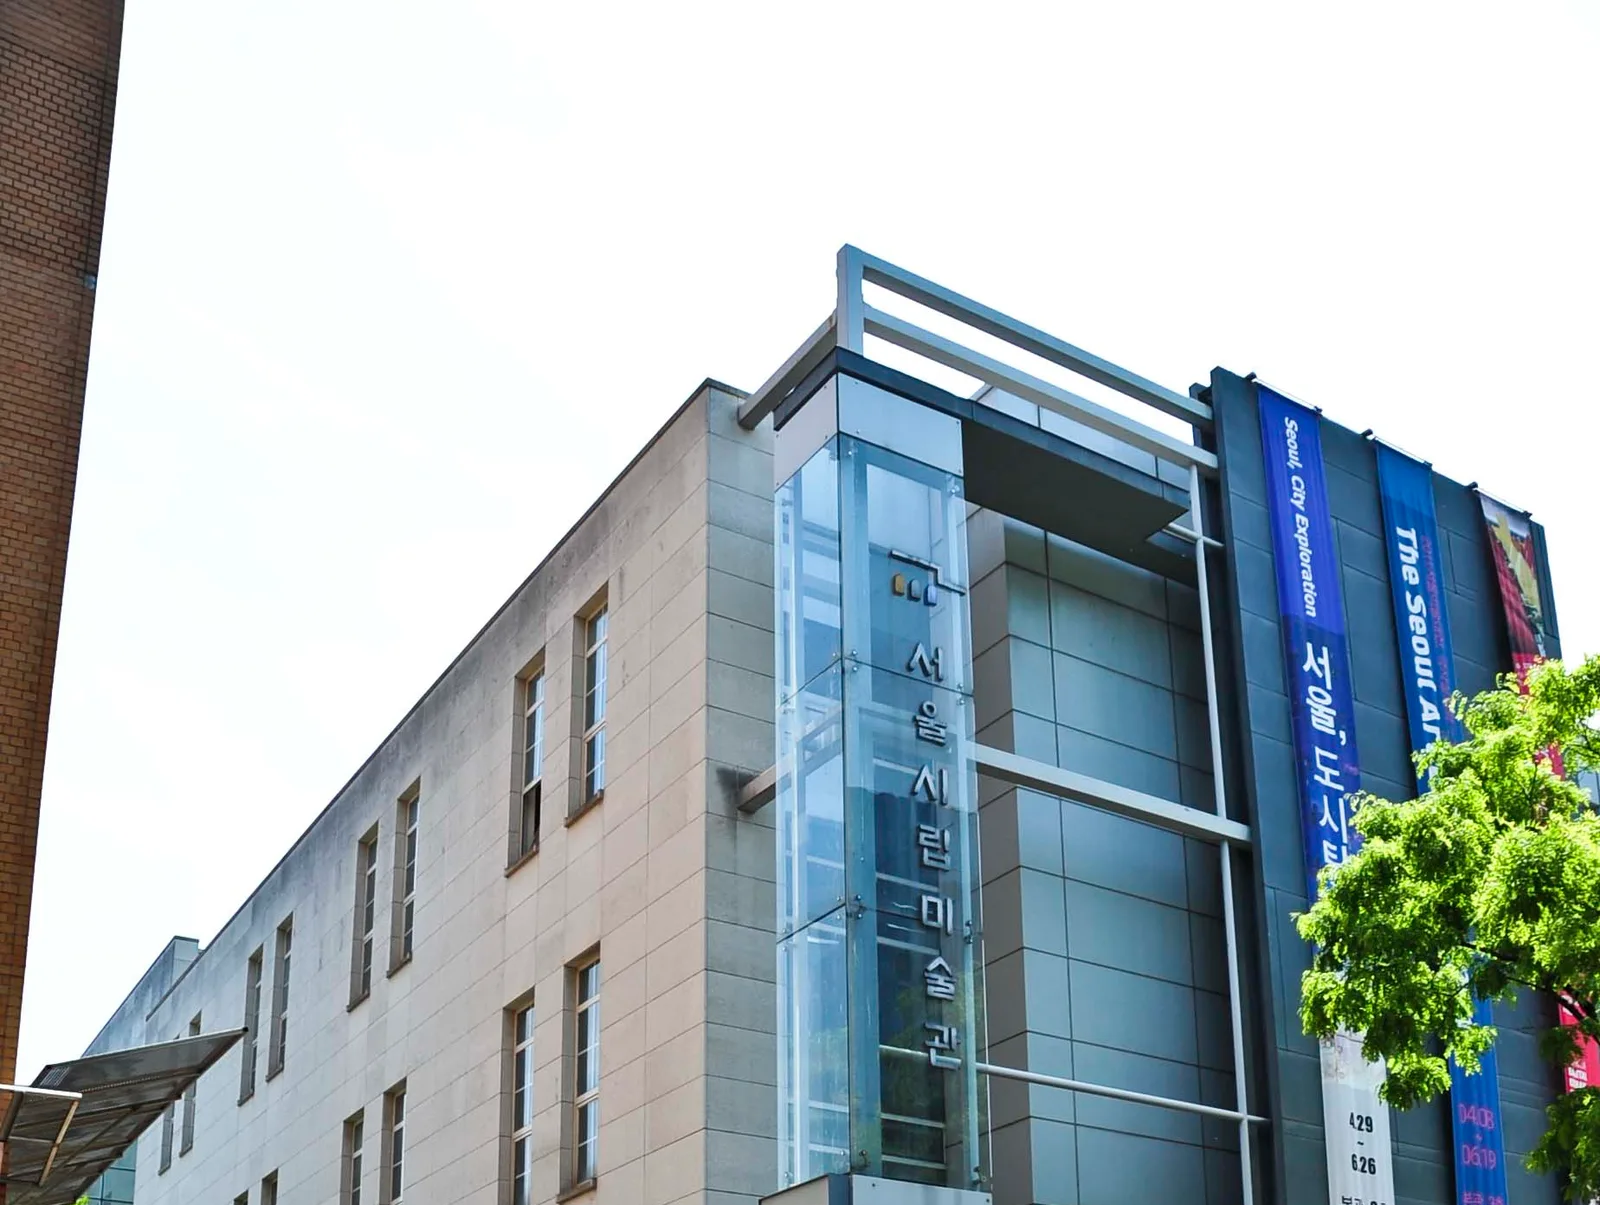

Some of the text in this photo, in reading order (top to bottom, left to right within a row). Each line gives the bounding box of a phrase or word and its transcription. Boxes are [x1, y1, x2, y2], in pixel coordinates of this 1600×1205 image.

[1284, 416, 1317, 619] Seoul, City Exploration
[1395, 526, 1419, 587] The
[1406, 591, 1435, 692] Seoul
[1420, 695, 1441, 753] Ar
[907, 641, 962, 1071] 서울시립미술관
[1349, 1111, 1374, 1133] 4.29
[1351, 1153, 1377, 1176] 6.26
